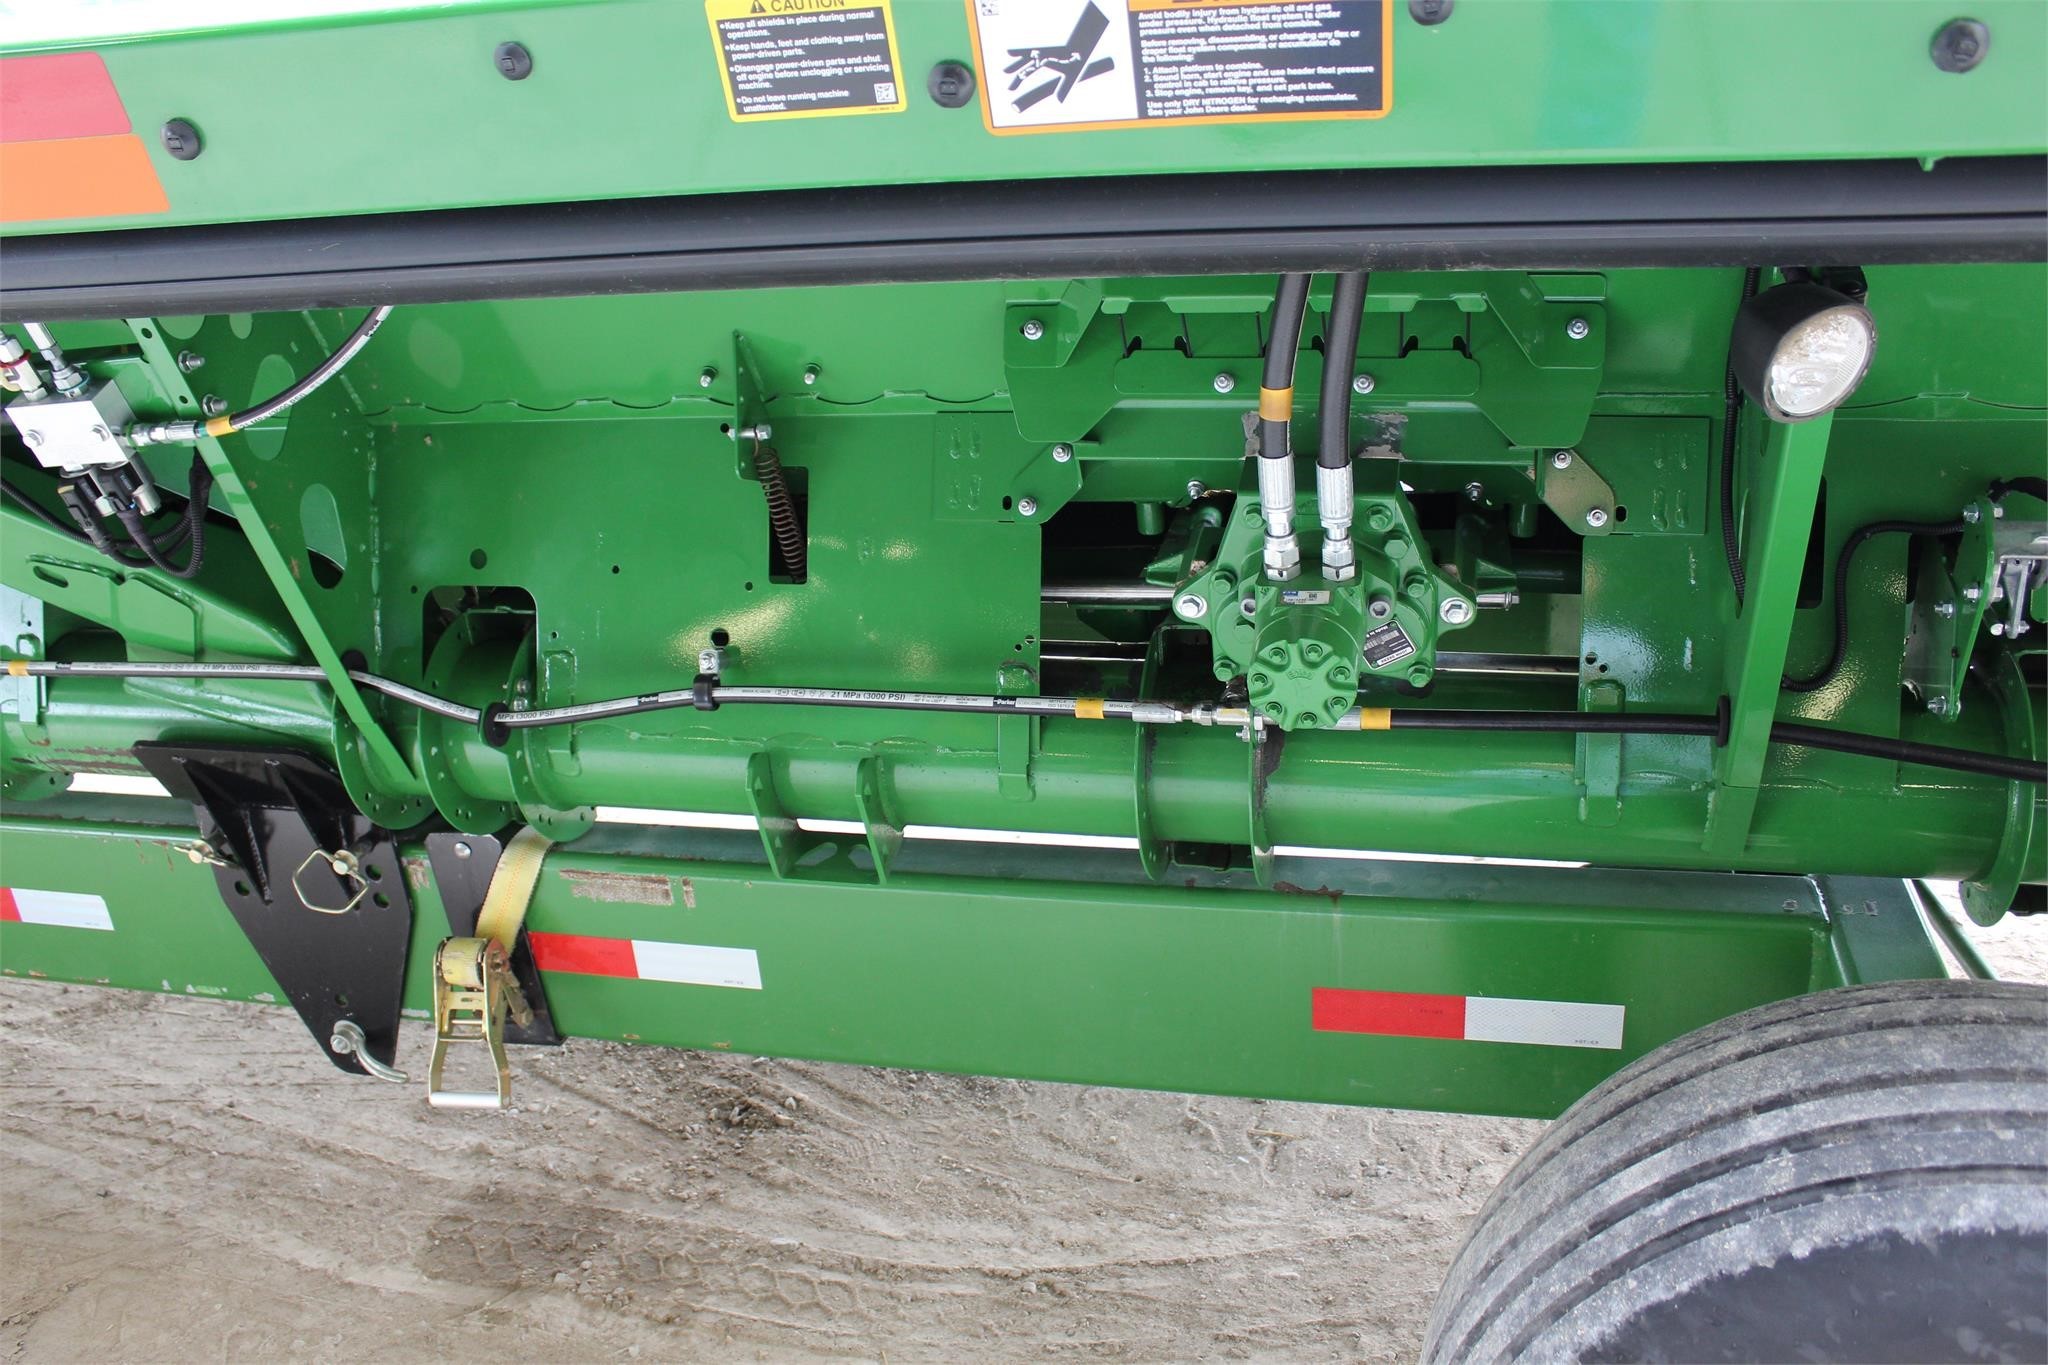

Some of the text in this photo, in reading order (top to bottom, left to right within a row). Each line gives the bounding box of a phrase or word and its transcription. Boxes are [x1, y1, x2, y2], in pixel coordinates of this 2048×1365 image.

[771, 0, 845, 12] CAUTION
[1139, 12, 1162, 20] Avoid
[1164, 10, 1190, 19] bodily
[1192, 9, 1217, 18] injury
[1241, 5, 1281, 15] hydraulic
[1315, 4, 1331, 12] gas
[747, 20, 755, 28] all
[758, 18, 785, 26] shields
[796, 16, 817, 25] place
[819, 13, 845, 22] during
[846, 11, 874, 20] normal
[1166, 19, 1205, 27] pressure.
[1207, 16, 1248, 25] Hydraulic
[1250, 13, 1269, 21] float
[1272, 13, 1303, 21] system
[727, 29, 770, 40] operations.
[1140, 28, 1175, 37] pressure
[1222, 23, 1260, 31] detached
[1283, 20, 1322, 28] combine.
[751, 41, 777, 49] hands,
[795, 37, 809, 46] and
[811, 36, 842, 45] clothing
[844, 34, 864, 43] away
[865, 32, 884, 40] from
[1168, 38, 1207, 46] removing,
[1279, 32, 1317, 41] changing
[1334, 30, 1349, 38] flex
[732, 48, 805, 62] power-driven parts.
[1142, 48, 1167, 56] draper
[1168, 46, 1186, 54] float
[1187, 45, 1216, 54] system
[1218, 42, 1266, 52] components
[1279, 40, 1328, 48] accumulator
[735, 64, 774, 73] Disengage
[775, 59, 824, 70] power-driven
[826, 57, 845, 67] parts
[1153, 66, 1178, 74] Attach
[1180, 64, 1214, 73] platform
[1226, 62, 1263, 70] combine.
[748, 73, 773, 81] engine
[775, 70, 799, 78] before
[800, 68, 843, 77] unclogging
[854, 64, 890, 72] servicing
[1153, 74, 1179, 82] Sound
[1224, 71, 1252, 79] engine
[1287, 67, 1315, 75] header
[1337, 66, 1374, 74] pressure
[739, 81, 773, 90] machine.
[1154, 81, 1182, 89] control
[1249, 77, 1287, 85] pressure.
[1175, 88, 1204, 96] engine,
[1206, 86, 1235, 94] remove
[1288, 83, 1306, 92] park
[1308, 82, 1334, 90] brake.
[767, 94, 786, 102] leave
[788, 92, 816, 101] running
[818, 90, 848, 98] machine
[1164, 100, 1181, 108] only
[1202, 97, 1245, 105] NITROGEN
[1260, 95, 1304, 103] recharging
[744, 103, 787, 112] unattended.
[1164, 108, 1183, 117] your
[1184, 106, 1204, 114] John
[1231, 104, 1257, 112] dealer.
[863, 692, 885, 700] (3000
